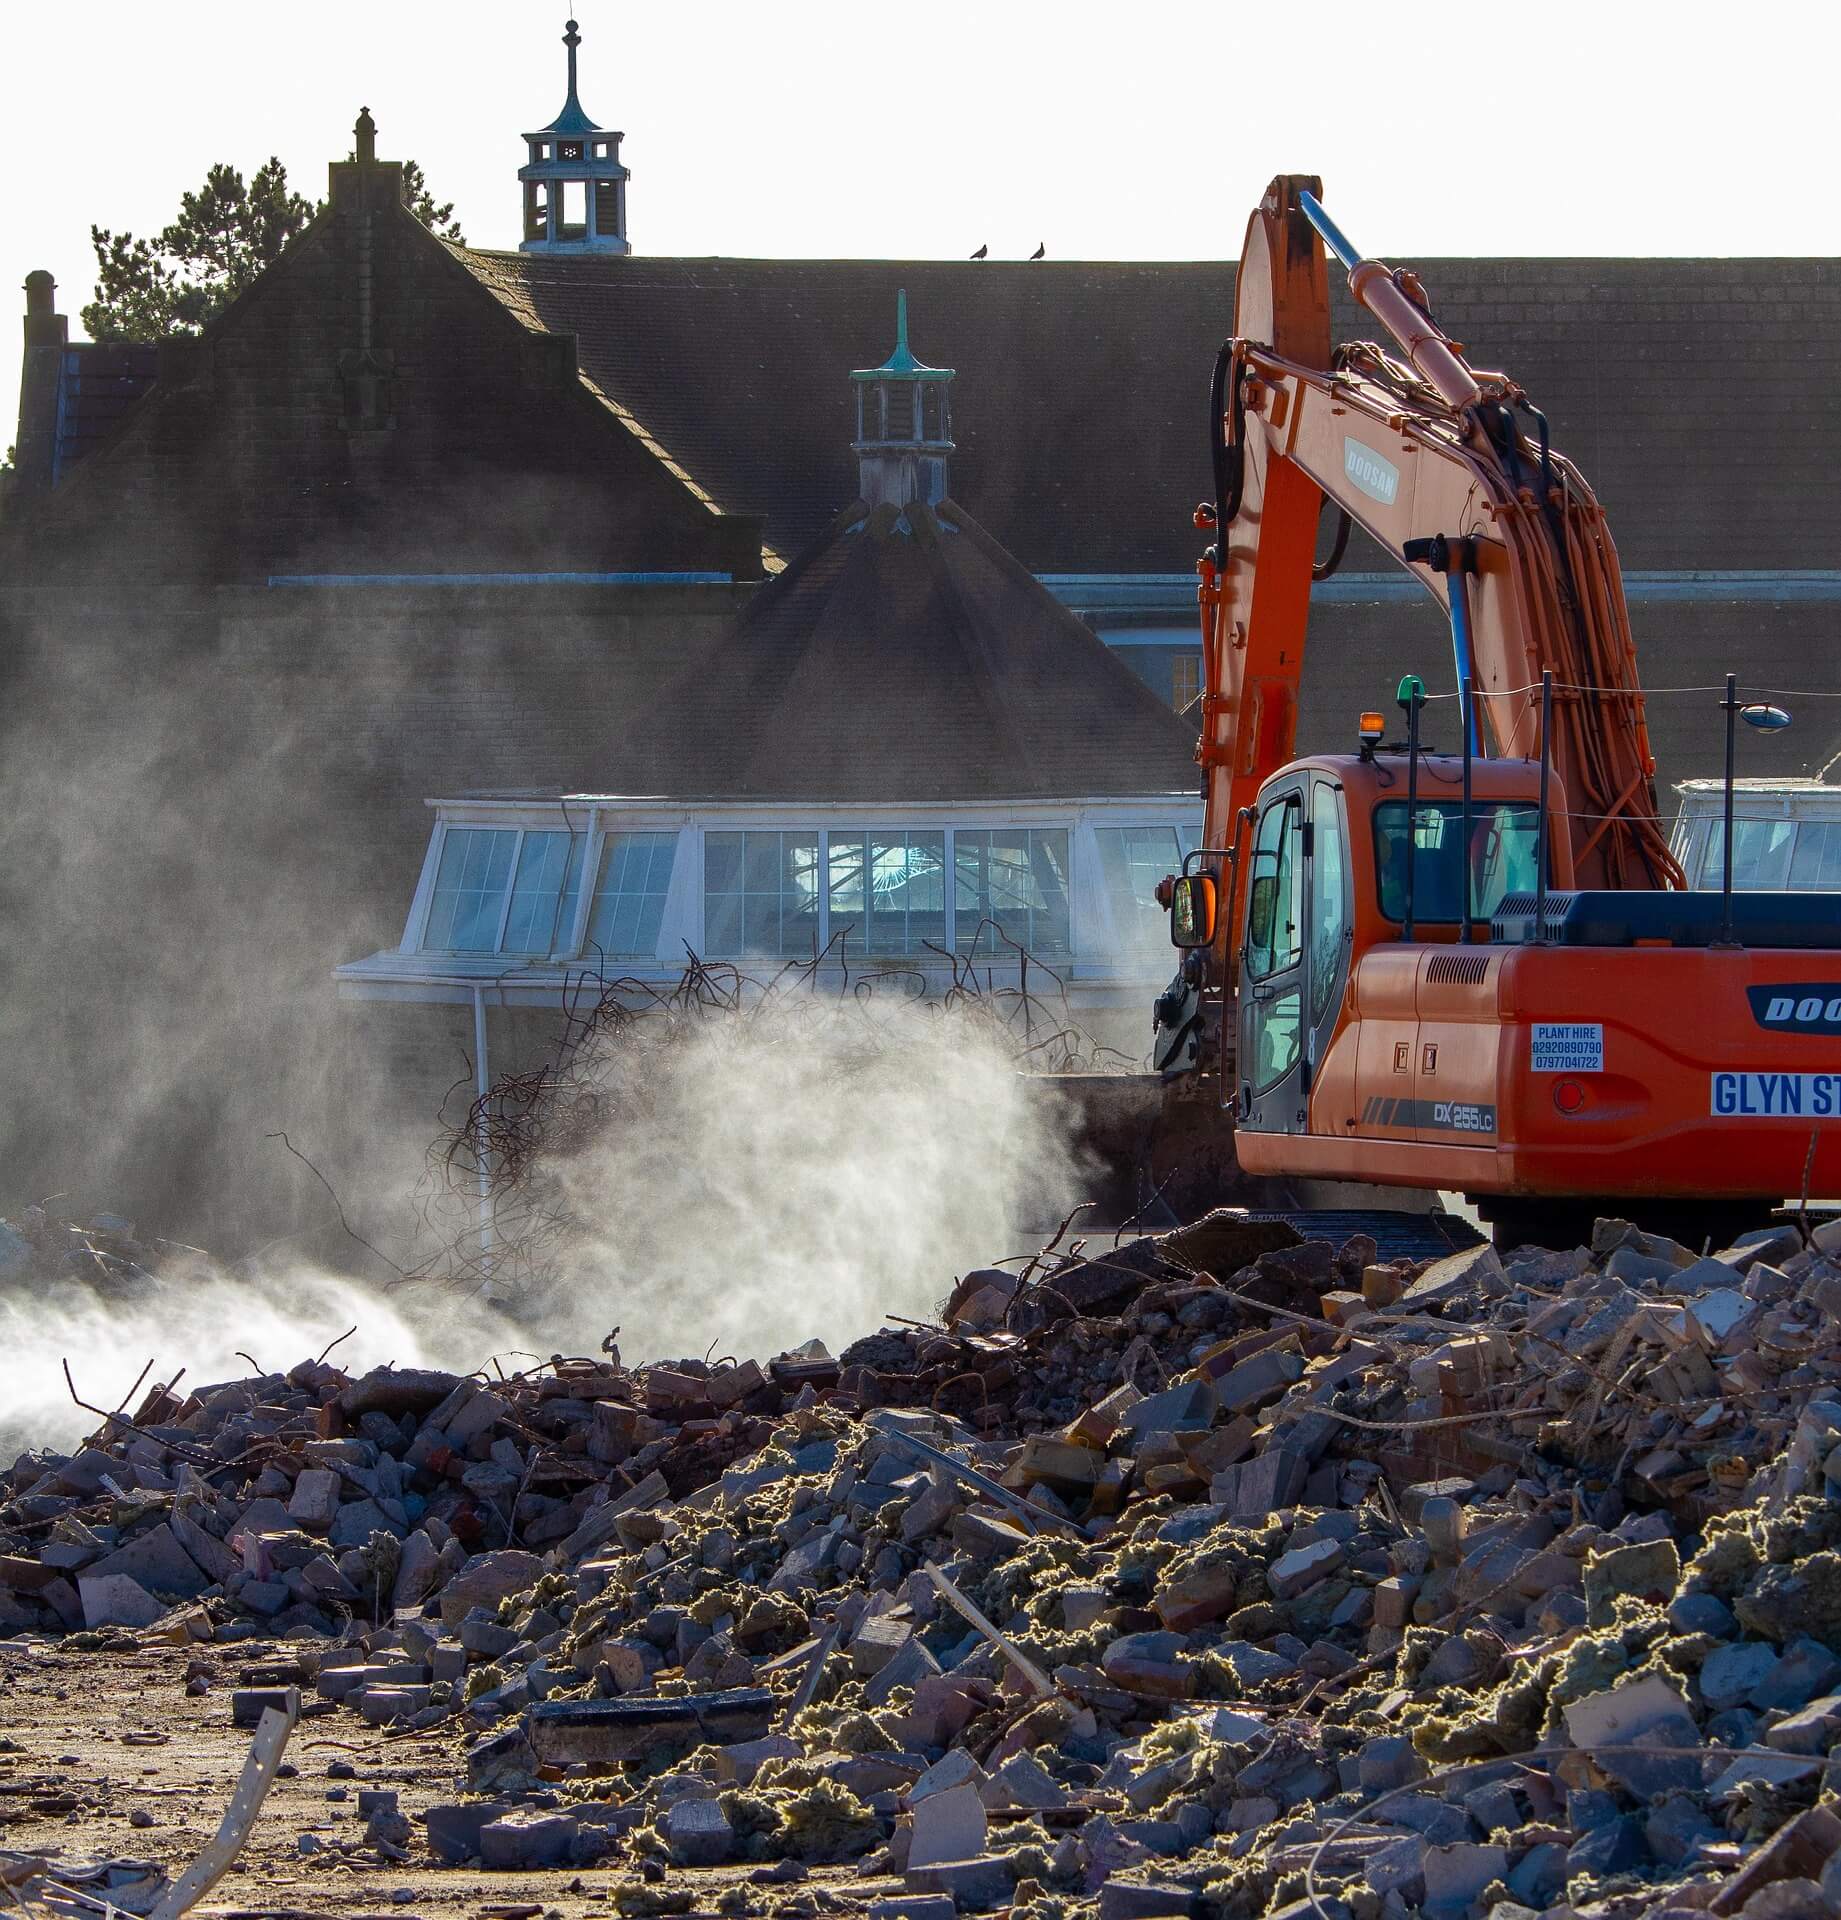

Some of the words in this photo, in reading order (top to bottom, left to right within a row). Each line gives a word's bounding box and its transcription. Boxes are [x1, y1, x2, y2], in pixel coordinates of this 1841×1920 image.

[1347, 449, 1395, 497] DOOSAN
[1538, 1027, 1571, 1039] PLANT
[1572, 1027, 1596, 1039] HIRE
[1532, 1041, 1602, 1054] 02920890790
[1535, 1056, 1599, 1069] 07977041722
[1715, 1073, 1801, 1114] GLYN
